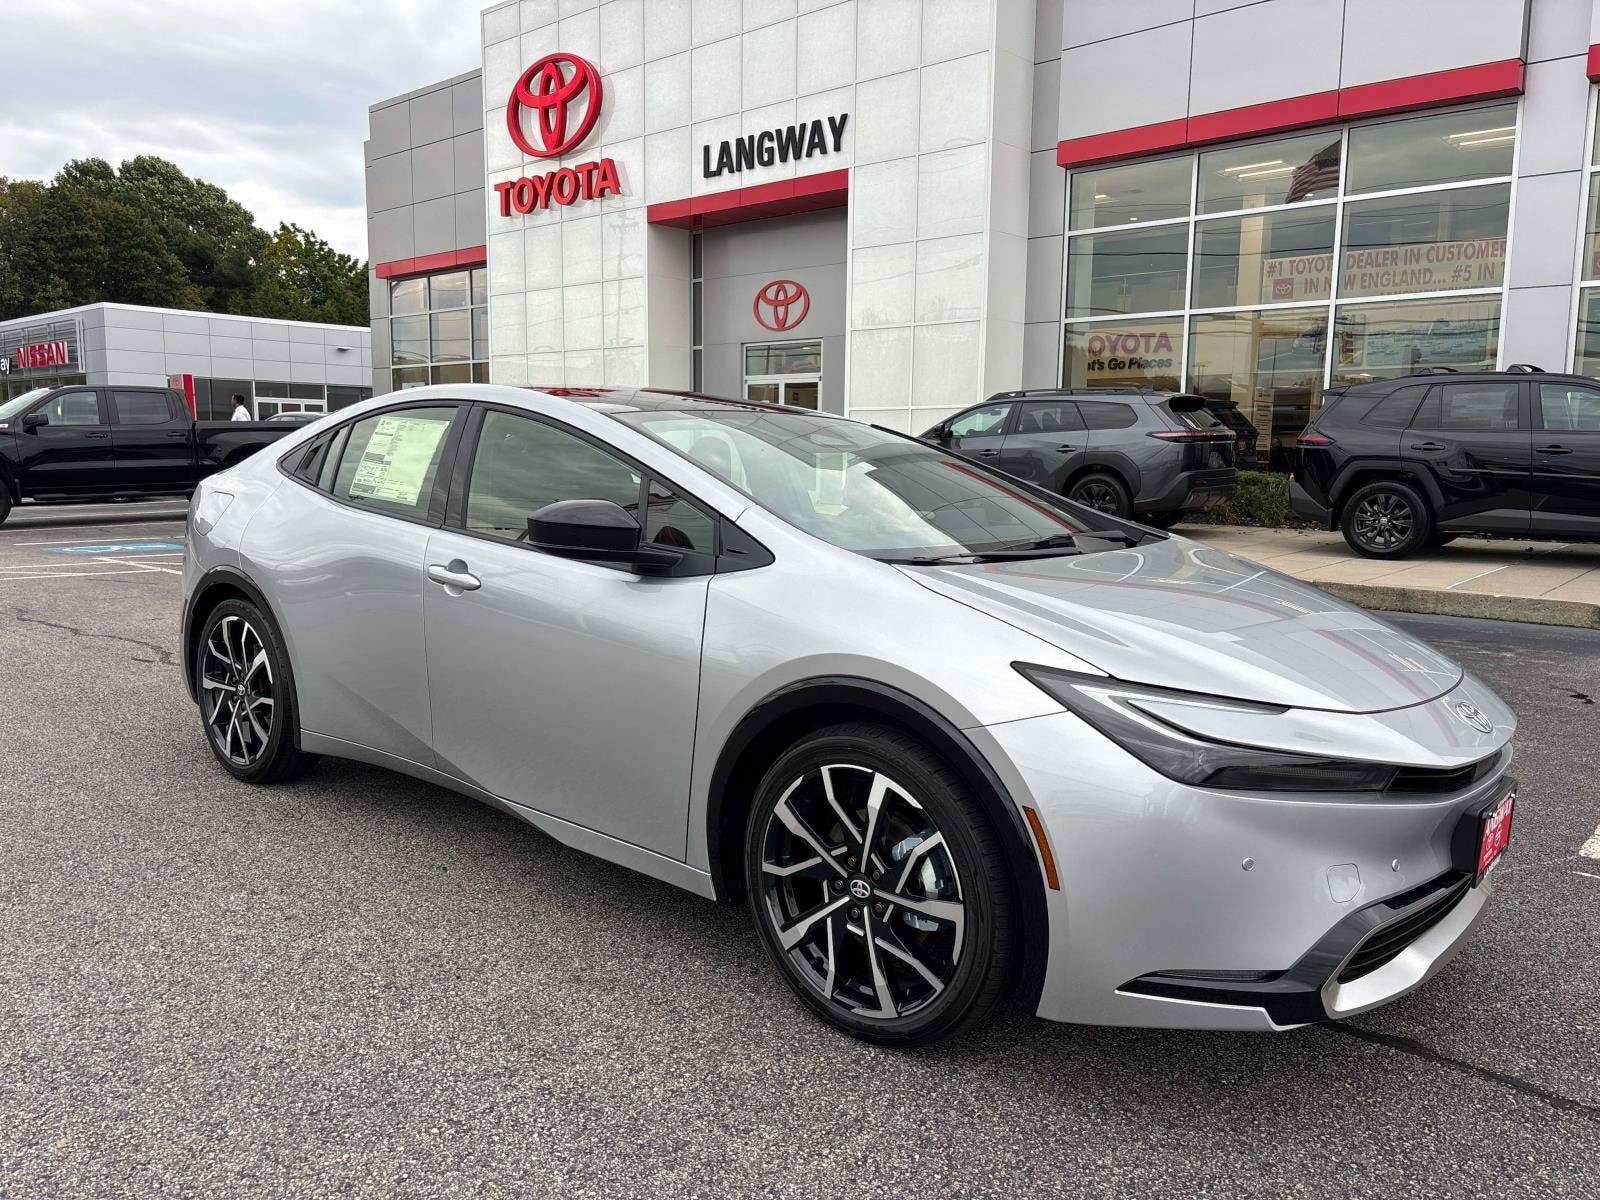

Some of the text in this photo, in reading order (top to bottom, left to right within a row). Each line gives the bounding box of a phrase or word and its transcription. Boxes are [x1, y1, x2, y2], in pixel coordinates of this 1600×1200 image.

[704, 113, 849, 179] LANGWAY
[494, 158, 621, 217] TOYOTA
[1266, 261, 1283, 279] #1
[1288, 256, 1334, 276] TOYOT
[1346, 250, 1399, 271] DEALER
[1403, 248, 1421, 267] IN
[1304, 278, 1319, 295] IN
[1323, 276, 1356, 294] NW
[1360, 269, 1446, 291] ENGLAND...
[1451, 264, 1472, 283] #5
[1477, 262, 1495, 281] IN
[16, 341, 66, 369] NISSAN
[1087, 332, 1173, 356] OYOTA
[1108, 357, 1126, 371] Go
[1128, 356, 1173, 370] Places
